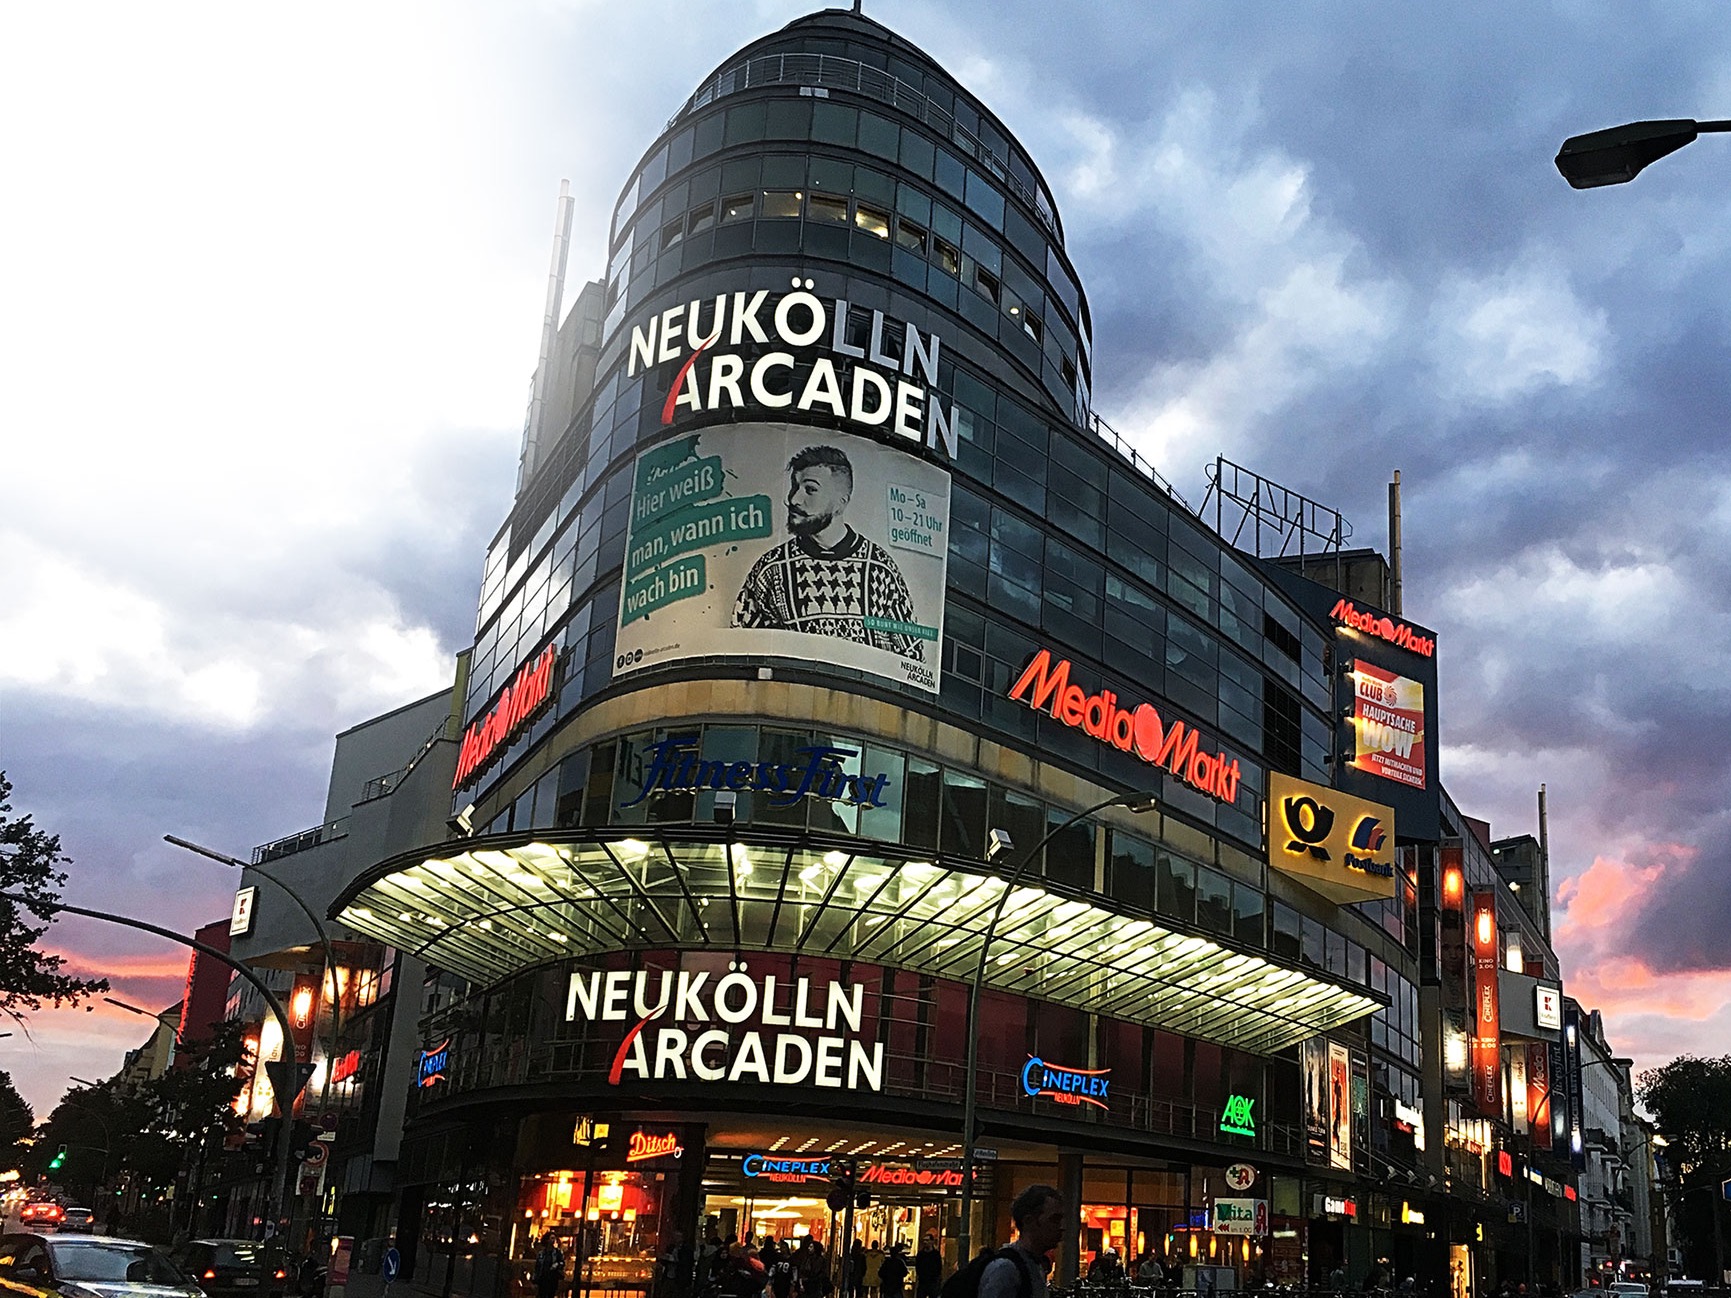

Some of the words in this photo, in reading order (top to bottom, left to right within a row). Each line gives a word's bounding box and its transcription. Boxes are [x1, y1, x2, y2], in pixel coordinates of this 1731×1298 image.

[627, 276, 940, 388] NEUKÖLLN
[661, 345, 959, 460] ARCADEN
[637, 490, 666, 521] Hier
[669, 465, 714, 503] weiß
[631, 537, 670, 568] man,
[670, 514, 724, 547] wann
[729, 504, 764, 531] ich
[891, 527, 933, 548] geöffnet
[925, 515, 942, 533] Uhr
[627, 578, 665, 614] wach
[668, 565, 699, 594] bin
[901, 661, 933, 680] NEUKÖLLN
[907, 672, 936, 689] ARCADEN
[1360, 681, 1383, 702] CLUB
[1008, 649, 1135, 752] Media
[1155, 720, 1241, 803] Markt
[1362, 703, 1416, 733] HAUPTSACHE
[1361, 717, 1415, 760] WOW
[620, 738, 792, 808] Fitness
[767, 746, 891, 810] First
[1344, 853, 1394, 878] Postbank
[565, 960, 864, 1032] NEUKÖLLN
[1483, 985, 1493, 1022] CINEPLEX
[608, 1024, 884, 1092] ARCADEN
[1023, 1057, 1110, 1098] CINEPLEX
[1486, 1065, 1495, 1103] CINEPLEX
[1054, 1092, 1081, 1105] NEUKÖLLN
[1221, 1094, 1255, 1128] AOK
[629, 1131, 677, 1157] Ditsch
[742, 1154, 831, 1178] CINEPLEX
[860, 1165, 916, 1185] Media
[1216, 1203, 1254, 1221] Vita
